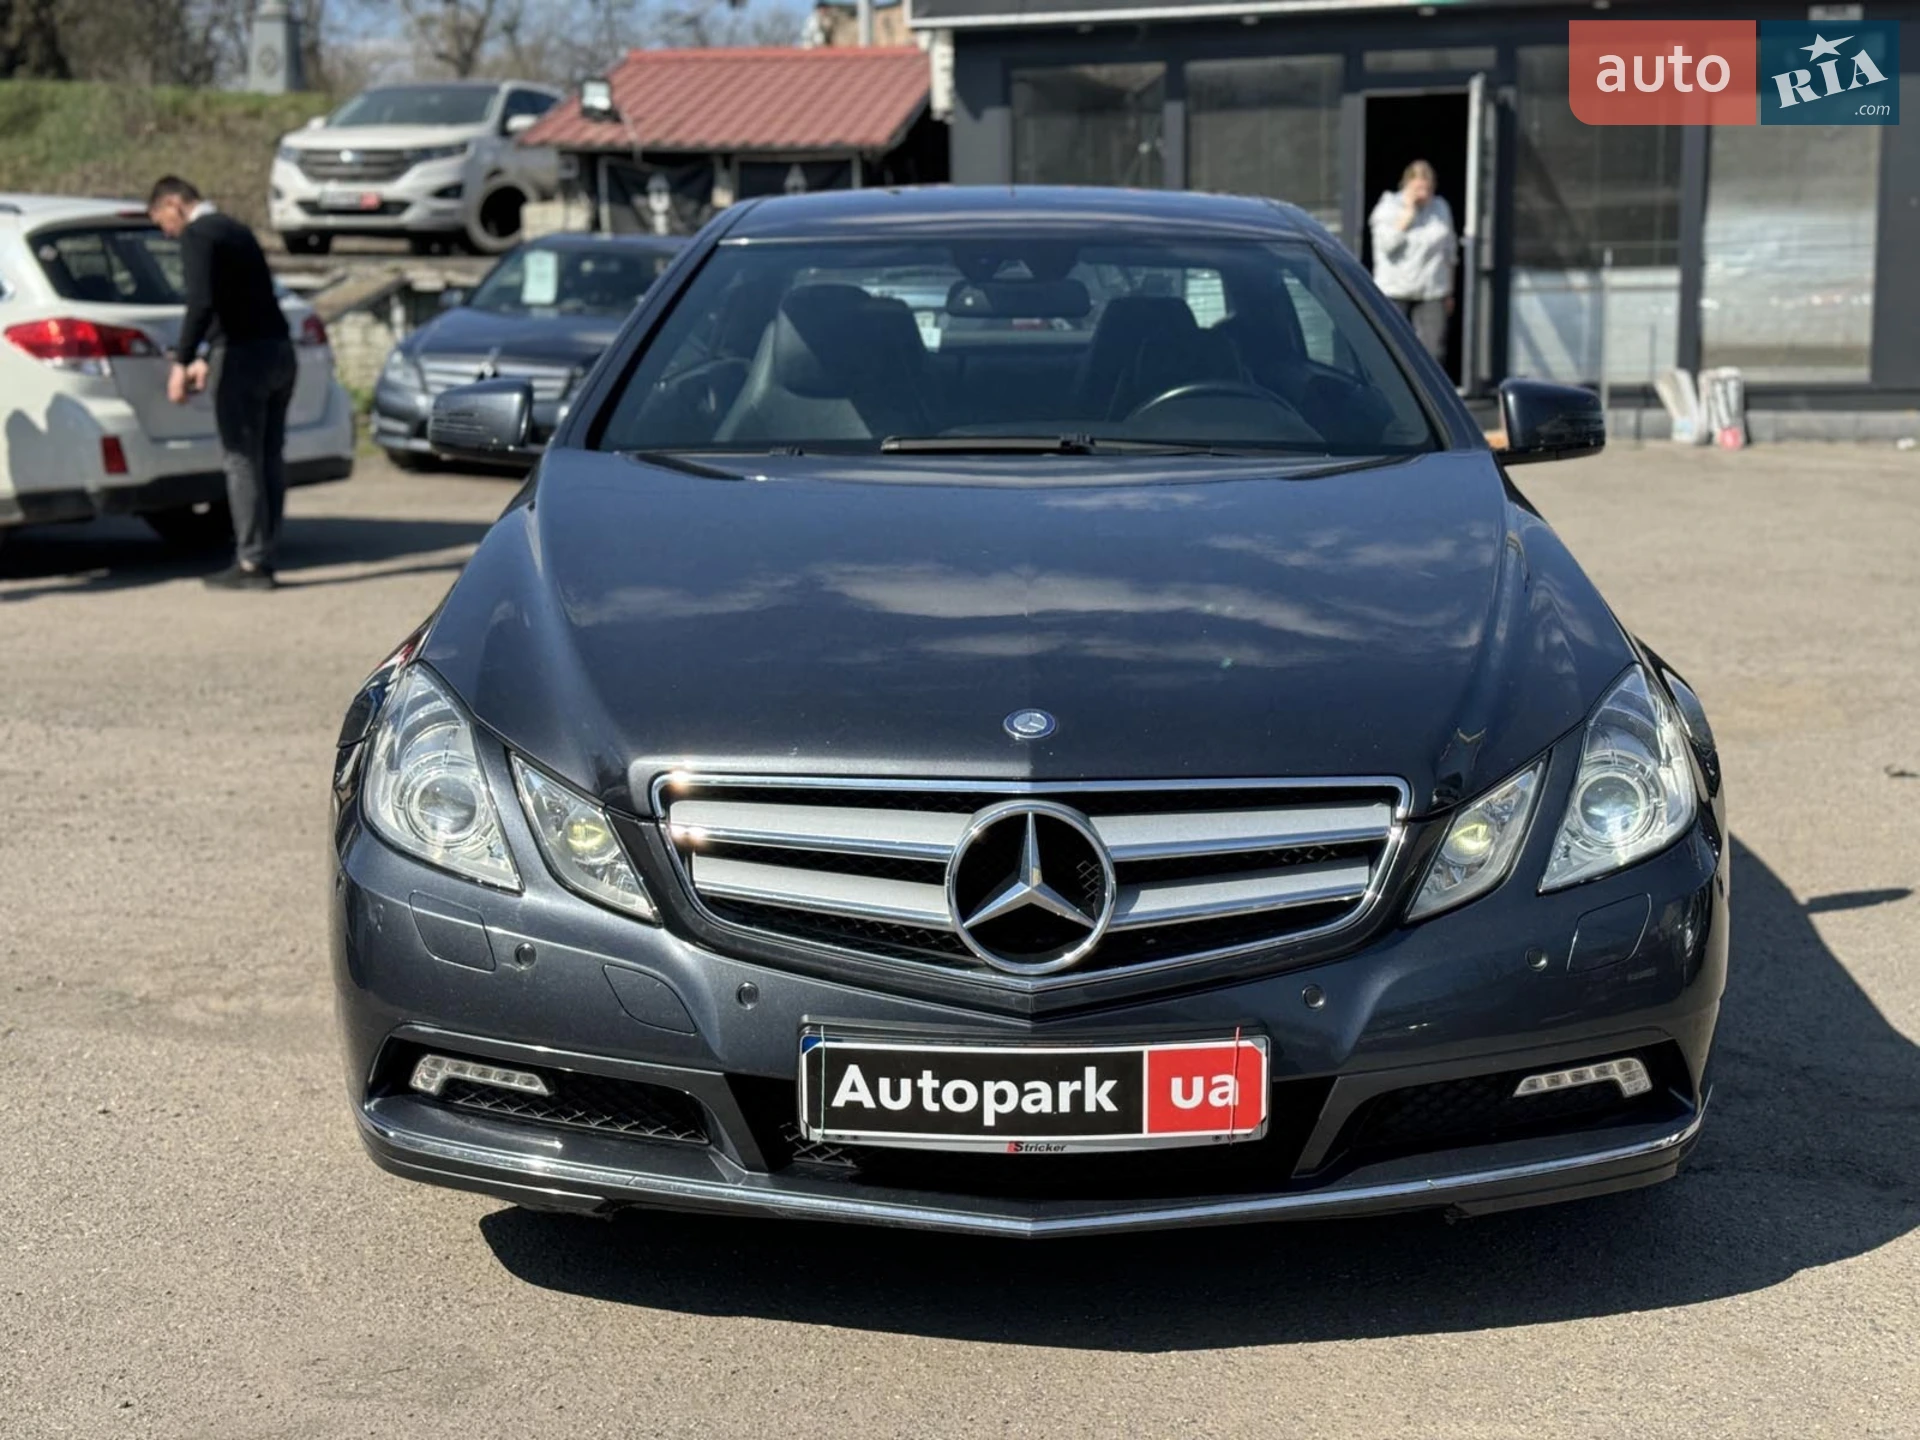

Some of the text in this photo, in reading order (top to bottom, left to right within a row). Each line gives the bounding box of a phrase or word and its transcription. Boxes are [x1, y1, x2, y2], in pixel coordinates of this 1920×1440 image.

[831, 1063, 1239, 1127] Autopark ua
[1013, 1141, 1067, 1153] Stricker
